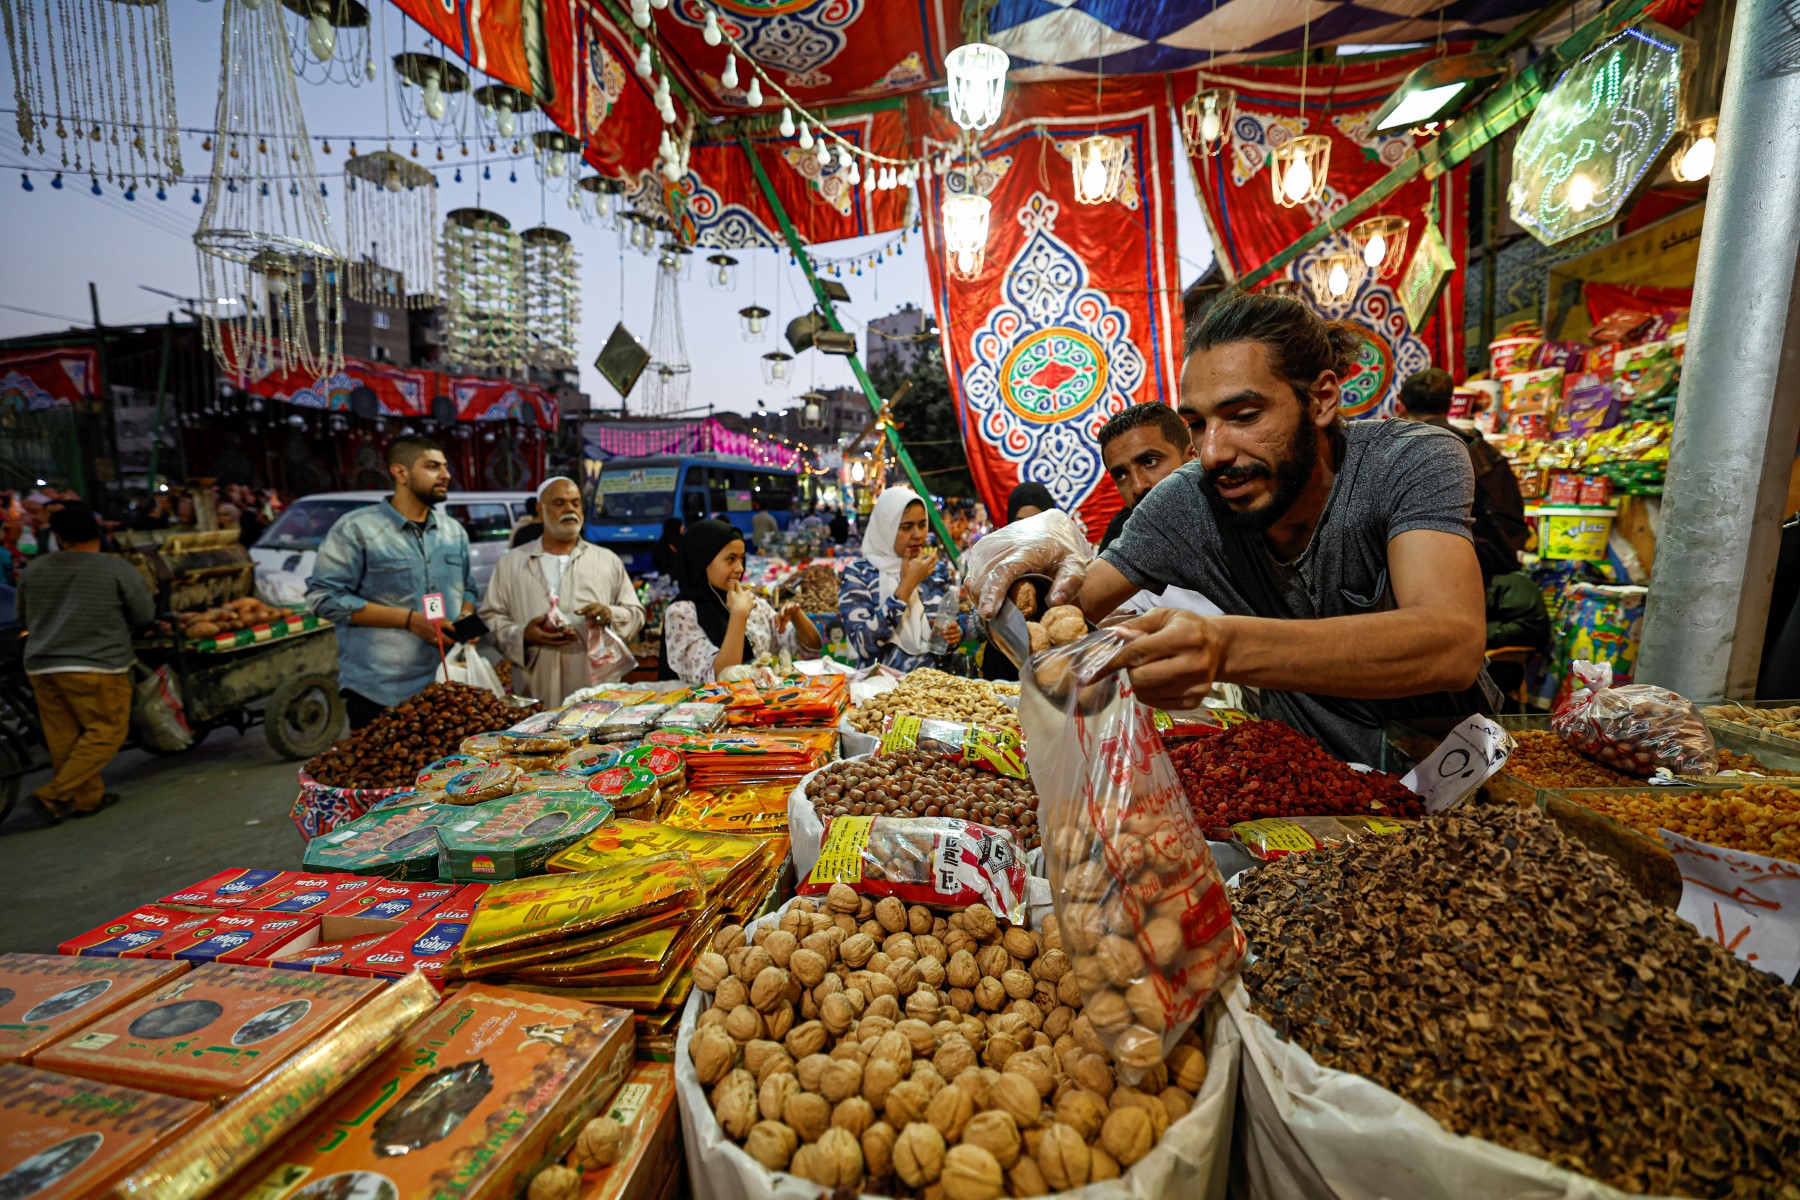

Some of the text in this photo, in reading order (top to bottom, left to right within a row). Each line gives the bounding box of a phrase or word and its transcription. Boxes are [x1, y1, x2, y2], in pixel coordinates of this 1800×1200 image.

[416, 935, 452, 952] Sobya
[447, 1009, 476, 1037] تمر
[434, 1110, 529, 1200] ELWAHAT
